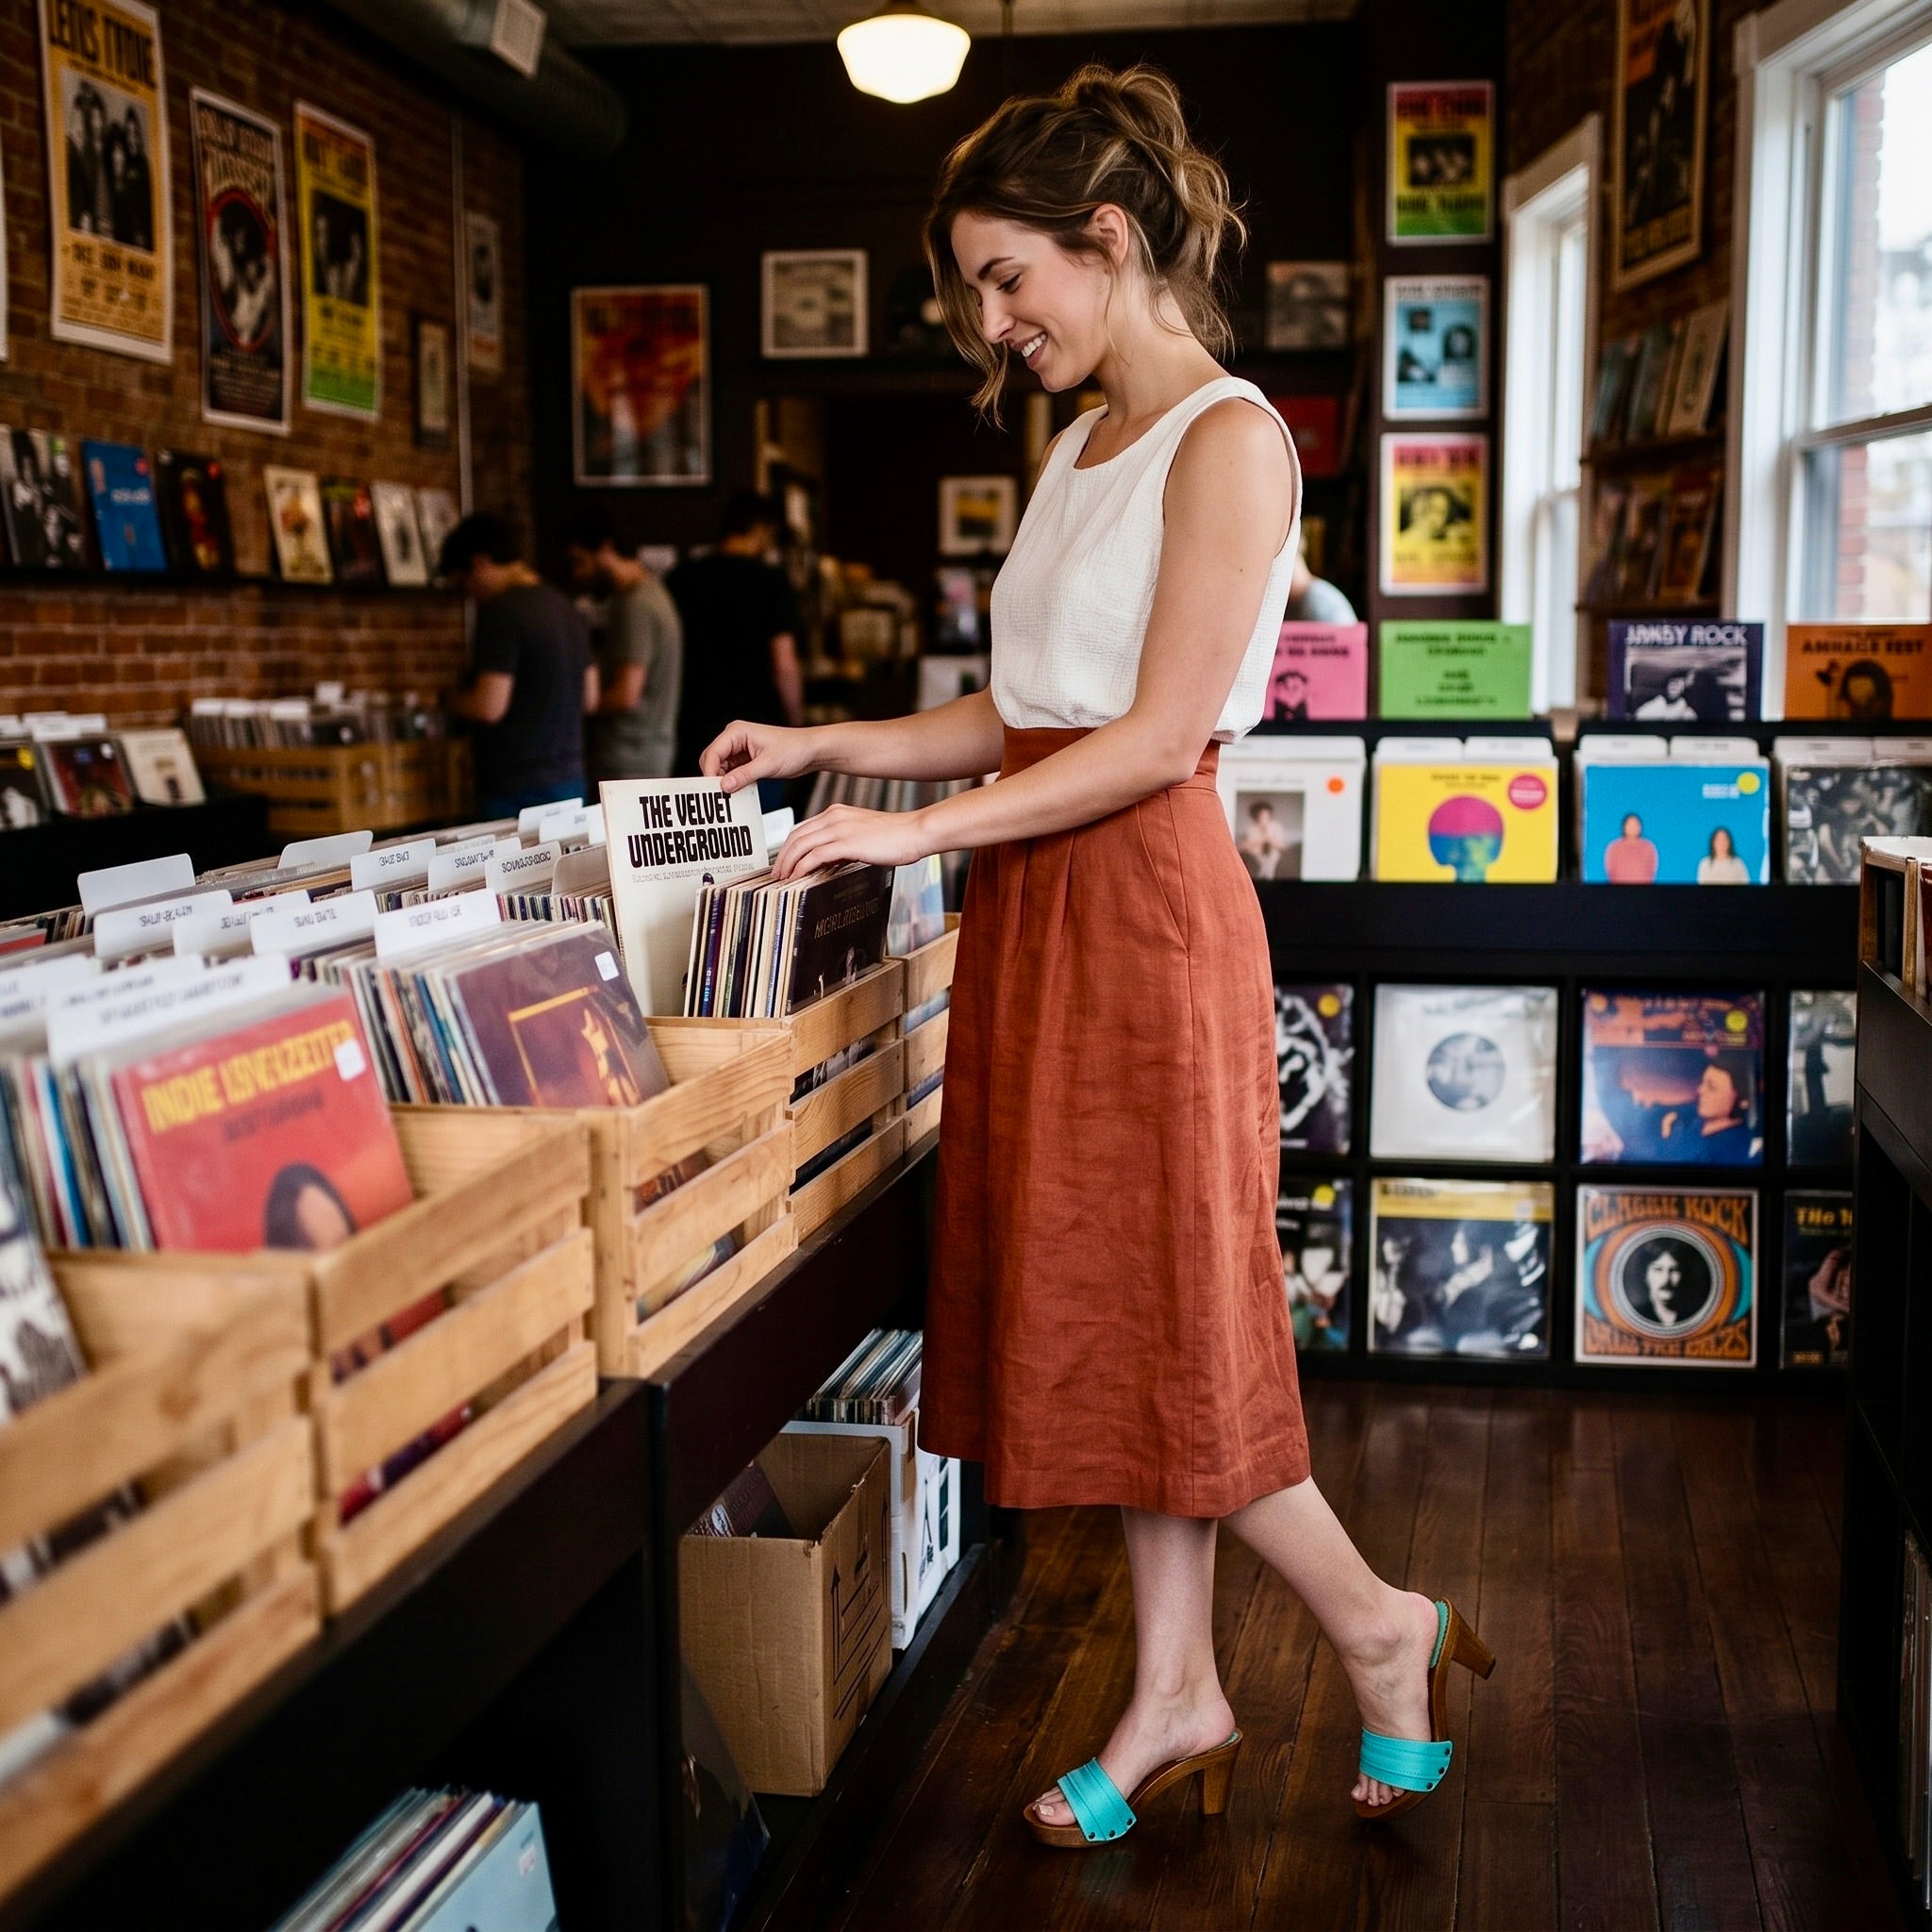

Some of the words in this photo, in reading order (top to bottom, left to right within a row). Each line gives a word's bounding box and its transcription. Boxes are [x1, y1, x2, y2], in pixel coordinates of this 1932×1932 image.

[1690, 624, 1748, 646] ROCK
[639, 794, 674, 829] THE
[675, 791, 733, 826] VELVET
[627, 825, 753, 868] UNDERGROUND
